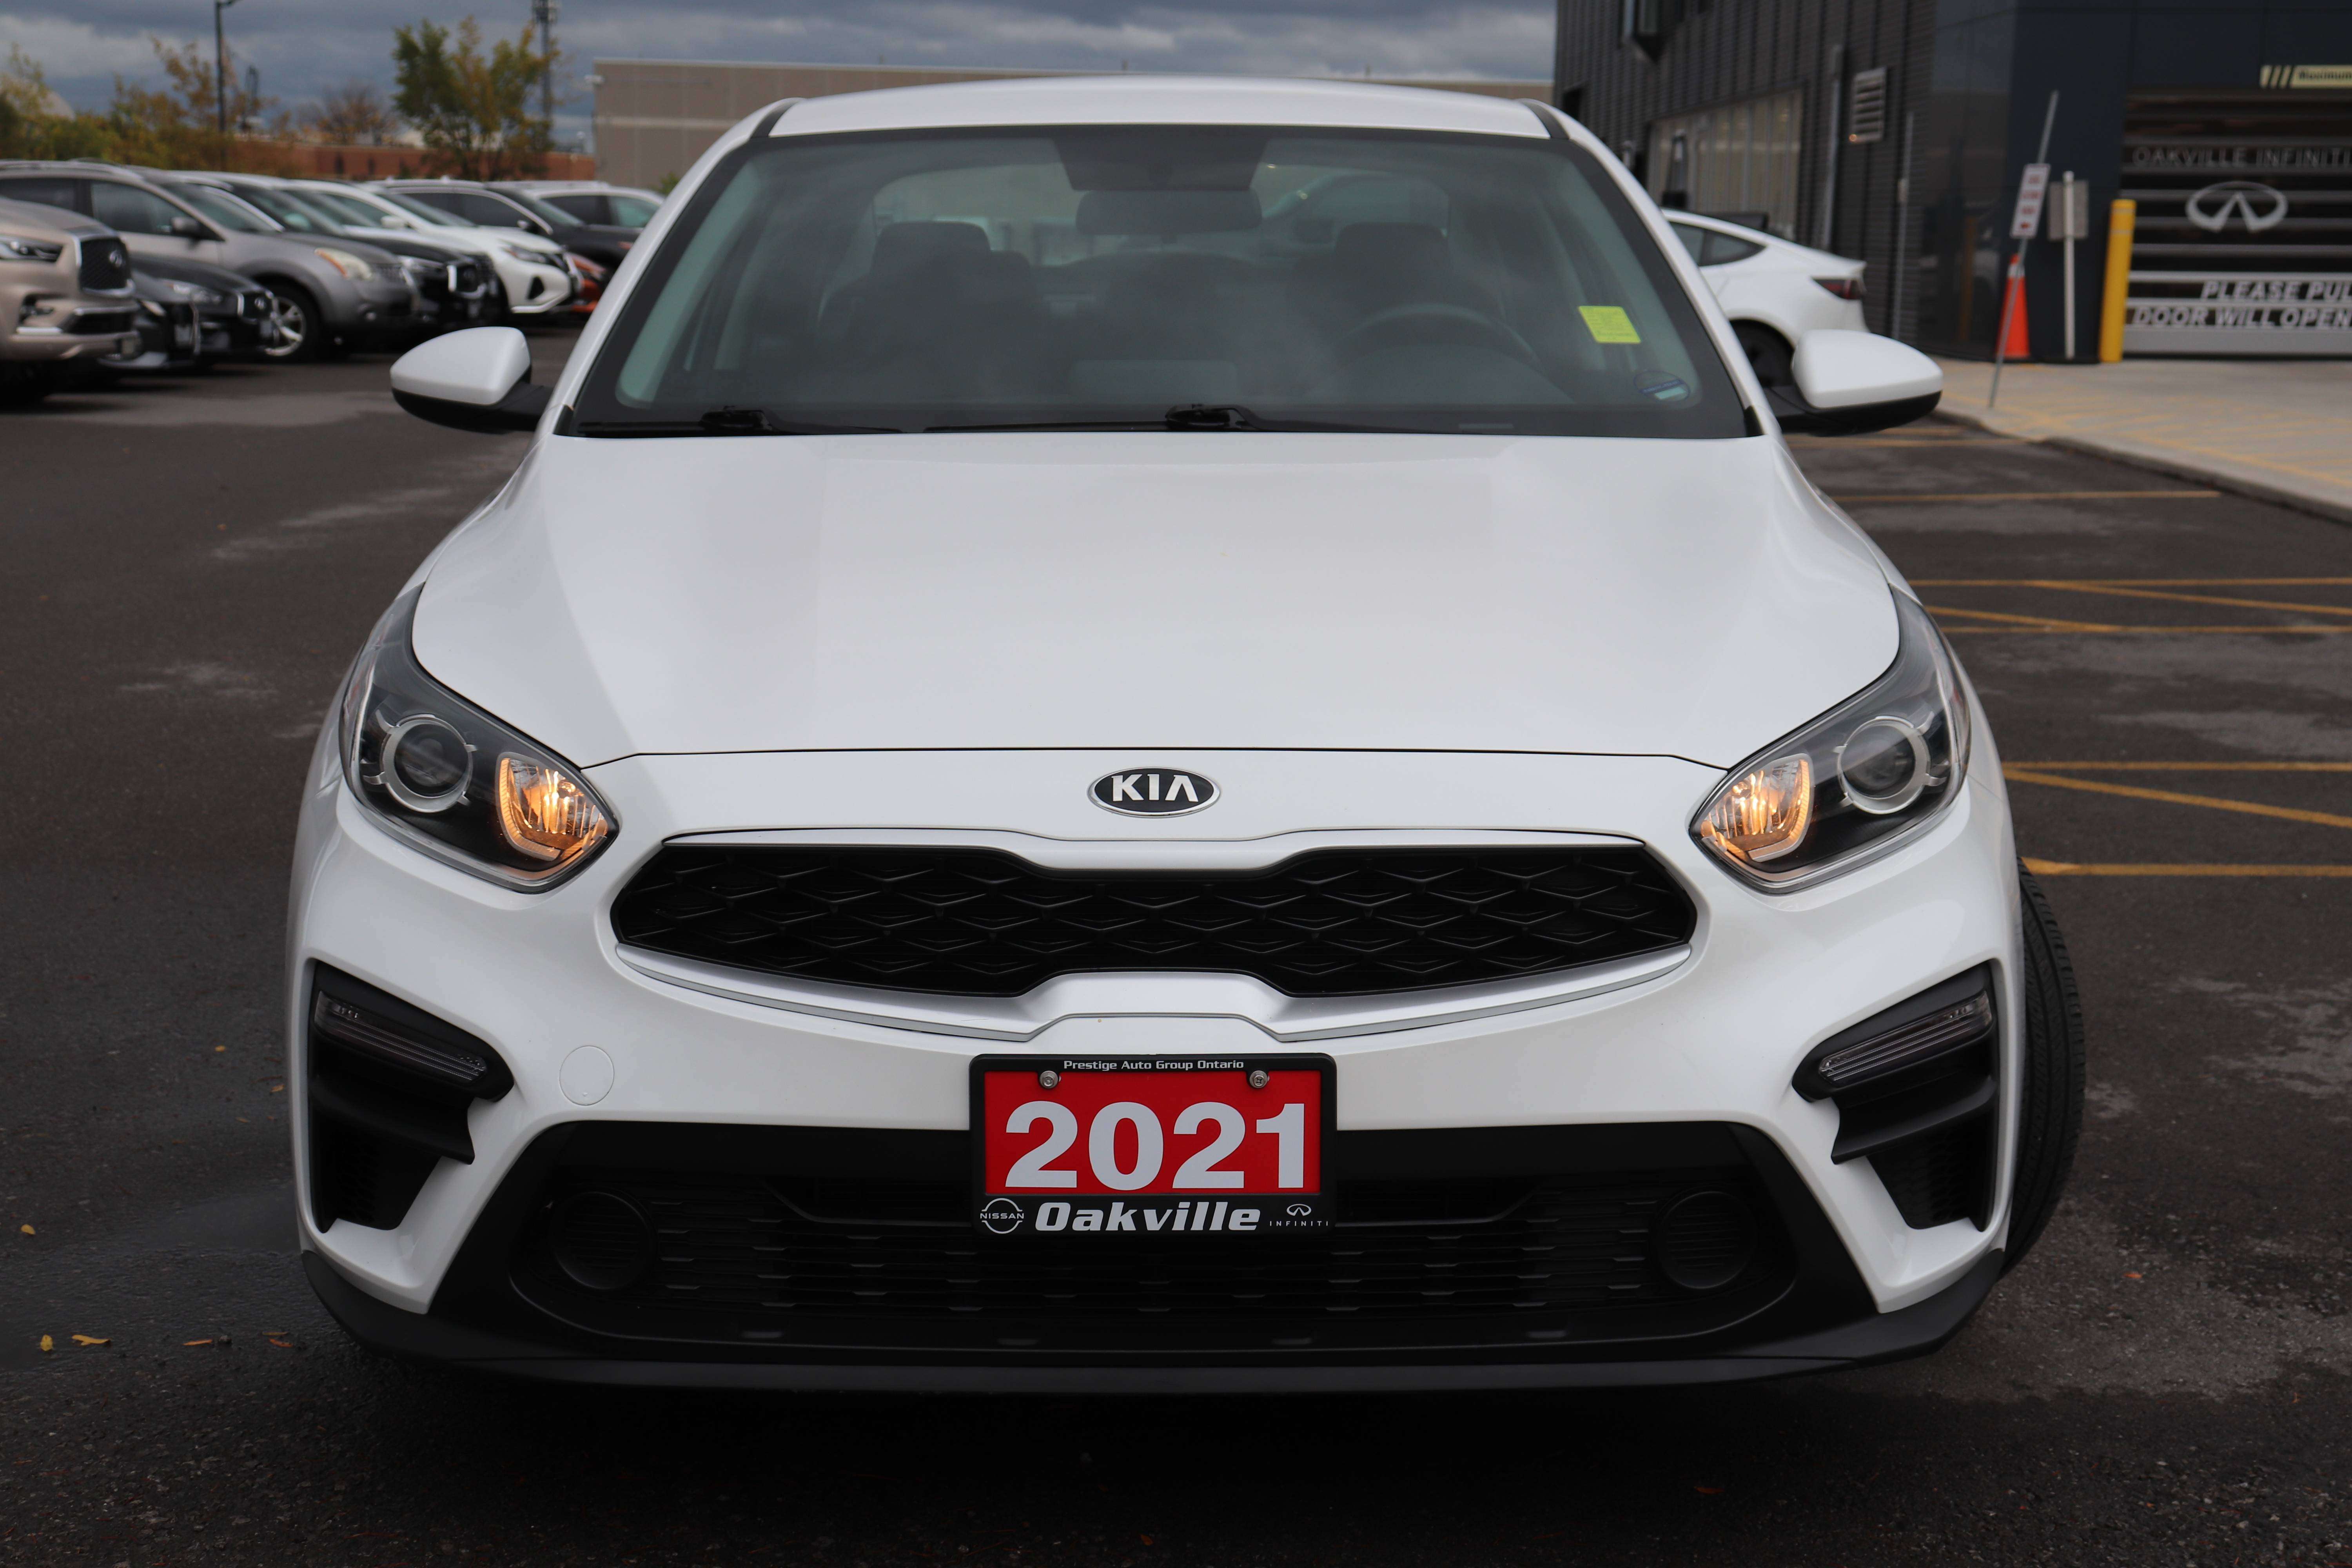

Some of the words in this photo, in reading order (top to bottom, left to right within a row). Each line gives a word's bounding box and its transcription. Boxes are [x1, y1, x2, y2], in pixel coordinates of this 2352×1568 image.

[2133, 147, 2247, 168] OAKVILLE
[2256, 147, 2352, 168] INFINITI
[2200, 281, 2300, 301] PLEASE
[2131, 307, 2208, 327] DOOR
[2214, 307, 2275, 327] WILL
[2279, 307, 2352, 327] OPEN
[1111, 773, 1199, 802] KIA
[1064, 1061, 1117, 1071] Prestige
[1121, 1061, 1152, 1069] Auto
[1156, 1061, 1193, 1071] Group
[1198, 1060, 1244, 1069] Ontario
[1005, 1101, 1304, 1190] 2021
[1036, 1202, 1260, 1230] Oakville
